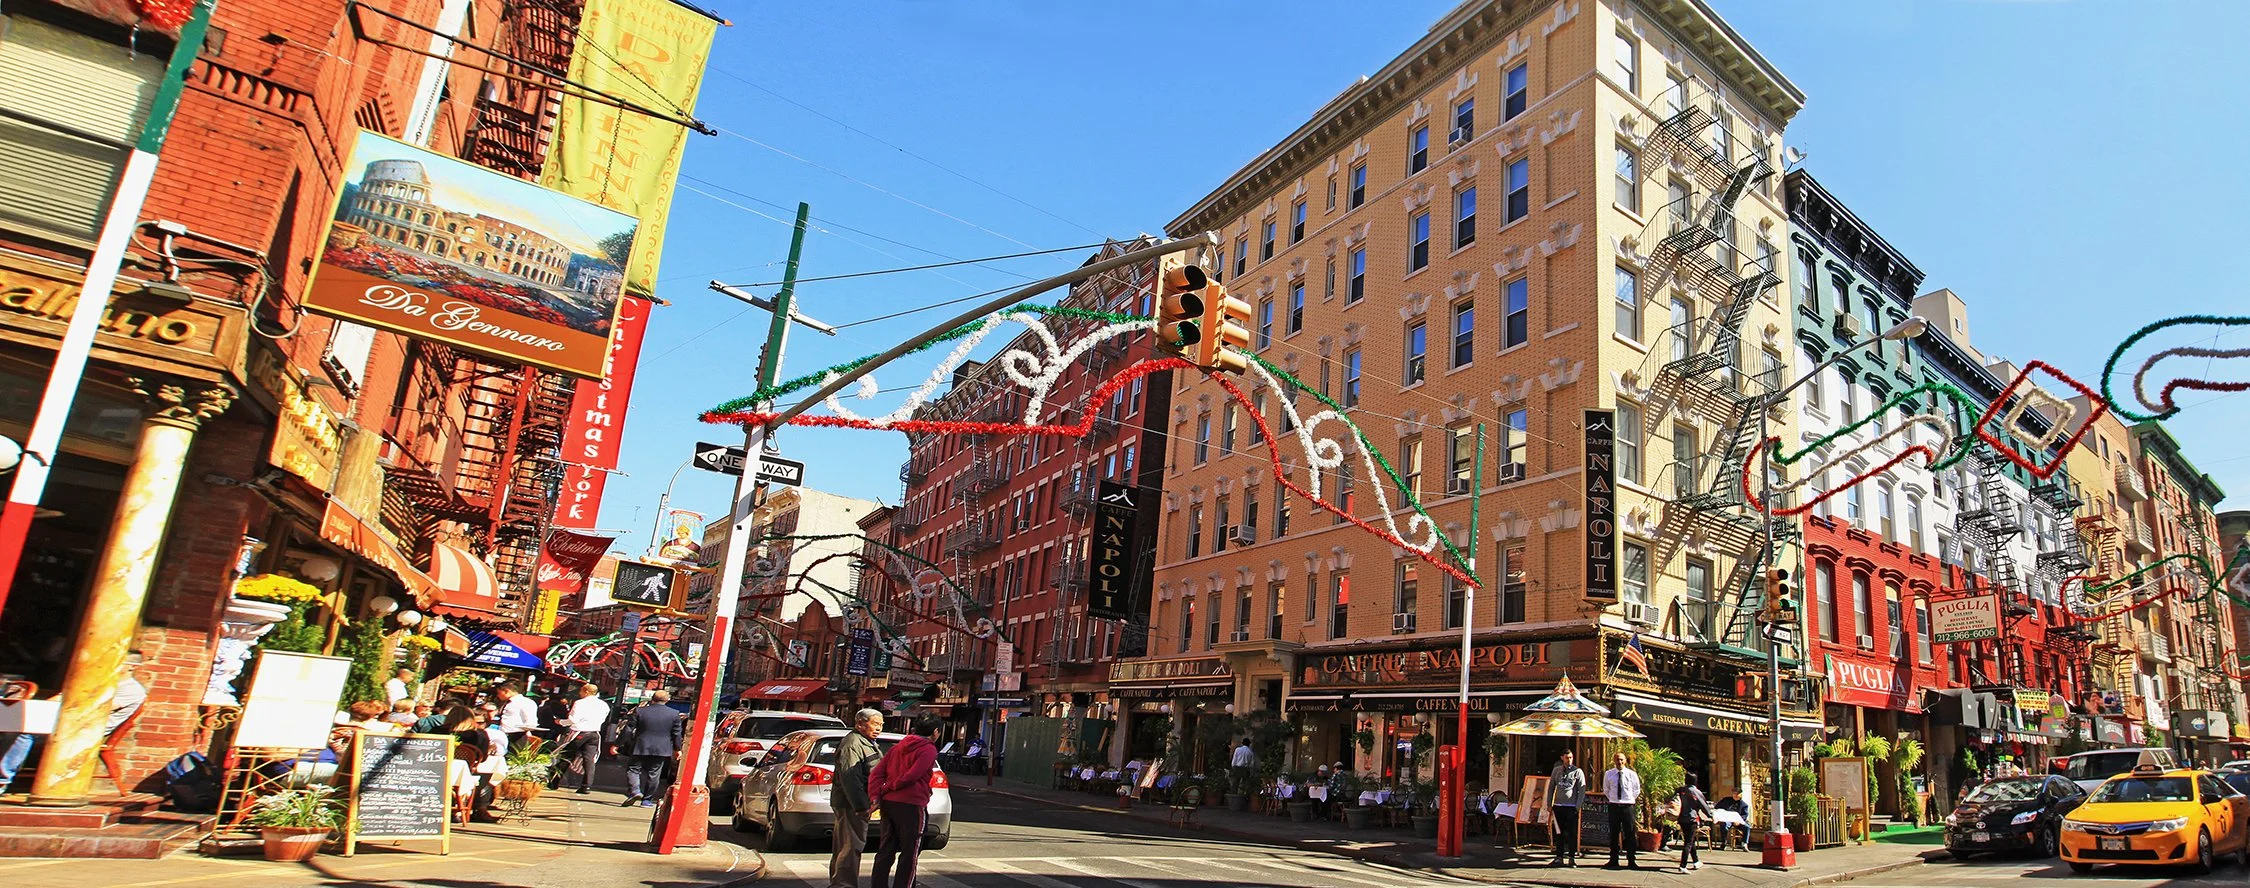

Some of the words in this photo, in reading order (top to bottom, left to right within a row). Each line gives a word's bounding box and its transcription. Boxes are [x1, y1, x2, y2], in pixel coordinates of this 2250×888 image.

[607, 2, 694, 44] ITALIANO
[632, 0, 711, 36] ORANTE
[0, 283, 197, 344] alino
[358, 284, 430, 317] Da
[429, 301, 566, 352] Gennaro
[706, 452, 742, 468] ONE
[761, 463, 794, 478] WAY
[1101, 505, 1133, 518] CAFFE
[1589, 453, 1613, 582] NAPOLI
[1099, 515, 1125, 608] NAPOLI
[1937, 600, 1991, 618] PUGLIA
[1937, 628, 1996, 642] 212-966-6006
[1323, 653, 1404, 675] CAFFE
[1426, 642, 1551, 671] NAPOLI
[1838, 661, 1906, 693] PUGLIA
[1416, 699, 1448, 711] CAFFE
[1652, 713, 1694, 727] RISTORANTE
[1708, 716, 1744, 735] CAFFE
